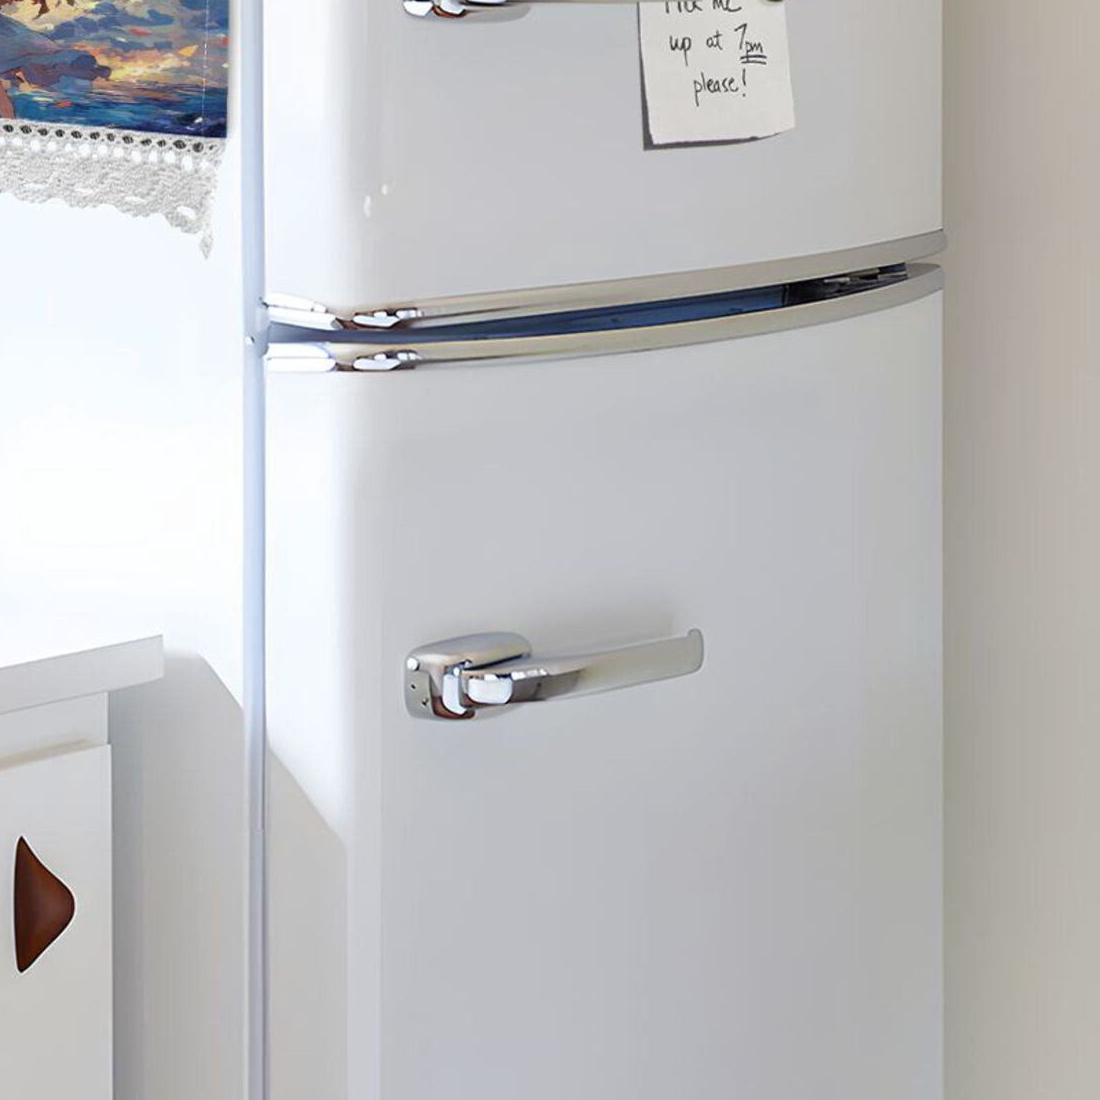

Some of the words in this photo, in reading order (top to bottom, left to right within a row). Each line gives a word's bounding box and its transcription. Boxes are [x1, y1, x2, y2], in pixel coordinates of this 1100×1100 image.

[669, 35, 692, 67] up
[706, 30, 723, 51] at
[693, 68, 747, 108] please!
